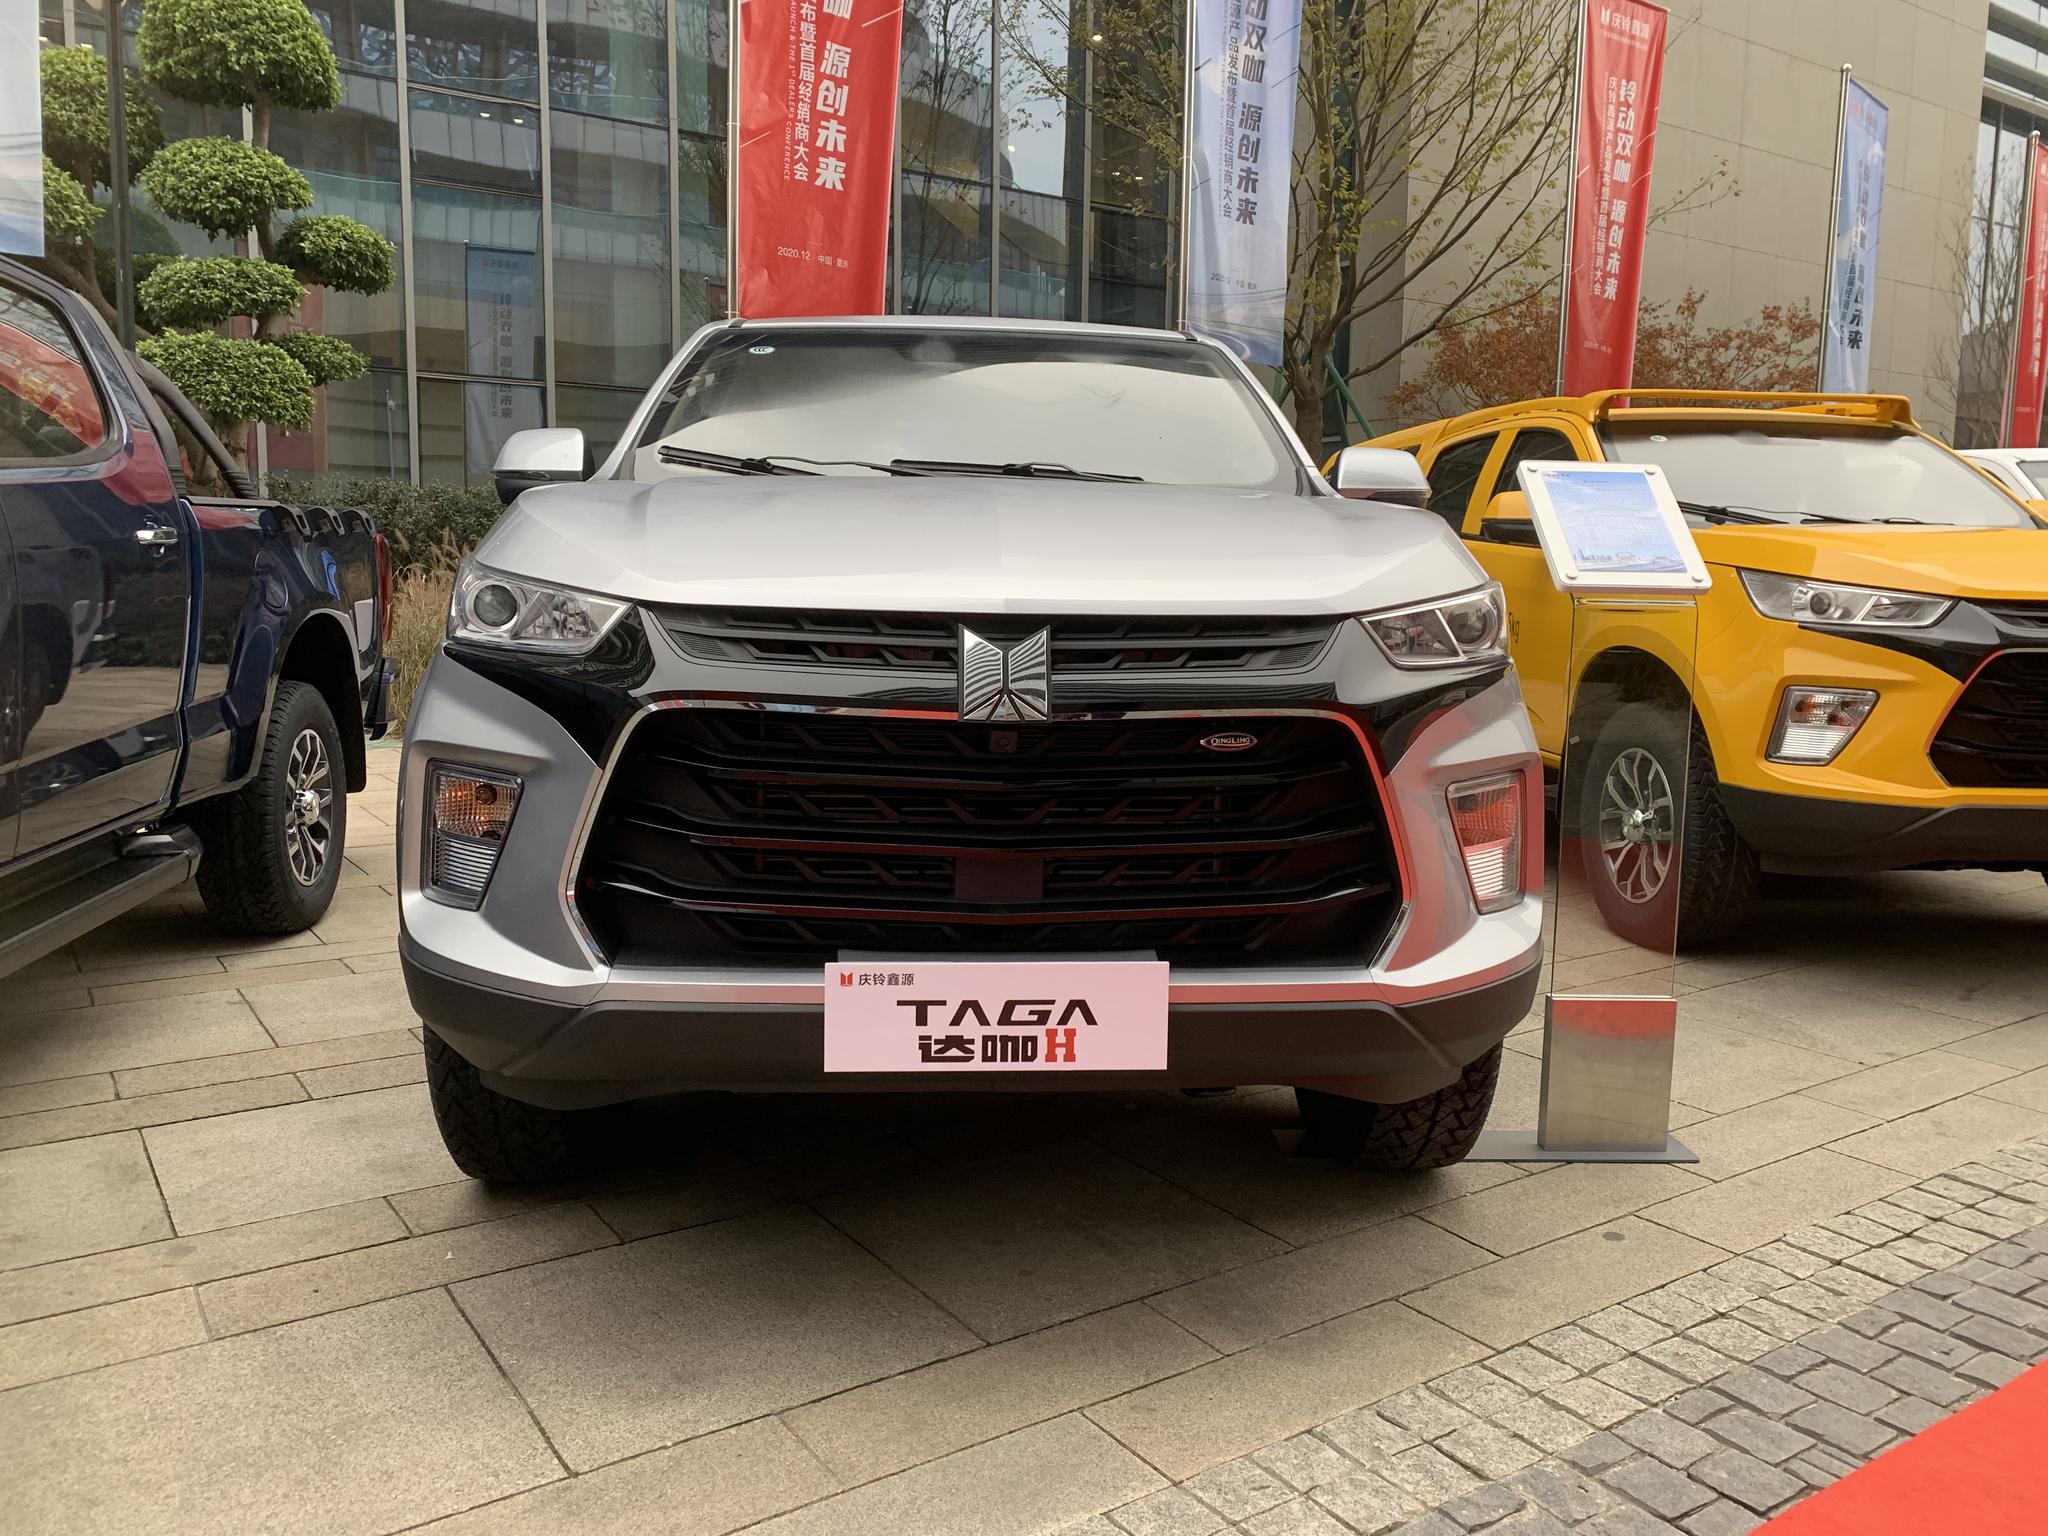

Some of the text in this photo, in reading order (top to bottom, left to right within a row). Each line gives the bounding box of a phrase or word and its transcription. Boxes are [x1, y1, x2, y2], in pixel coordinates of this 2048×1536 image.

[793, 0, 817, 182] 布暨首届经销商大会
[814, 40, 851, 192] 源创未来
[1223, 0, 1242, 219] 源产品发布暨首届经销商大会
[1613, 78, 1637, 183] 铃动双咖
[783, 121, 792, 181] CONFERENCE
[1236, 102, 1263, 225] 源创未来
[777, 246, 811, 261] 2020.12
[1603, 198, 1628, 301] 源创未来
[1210, 737, 1251, 745] QINGLING
[858, 972, 915, 987] 庆铃鑫源
[896, 999, 1099, 1027] TAGA
